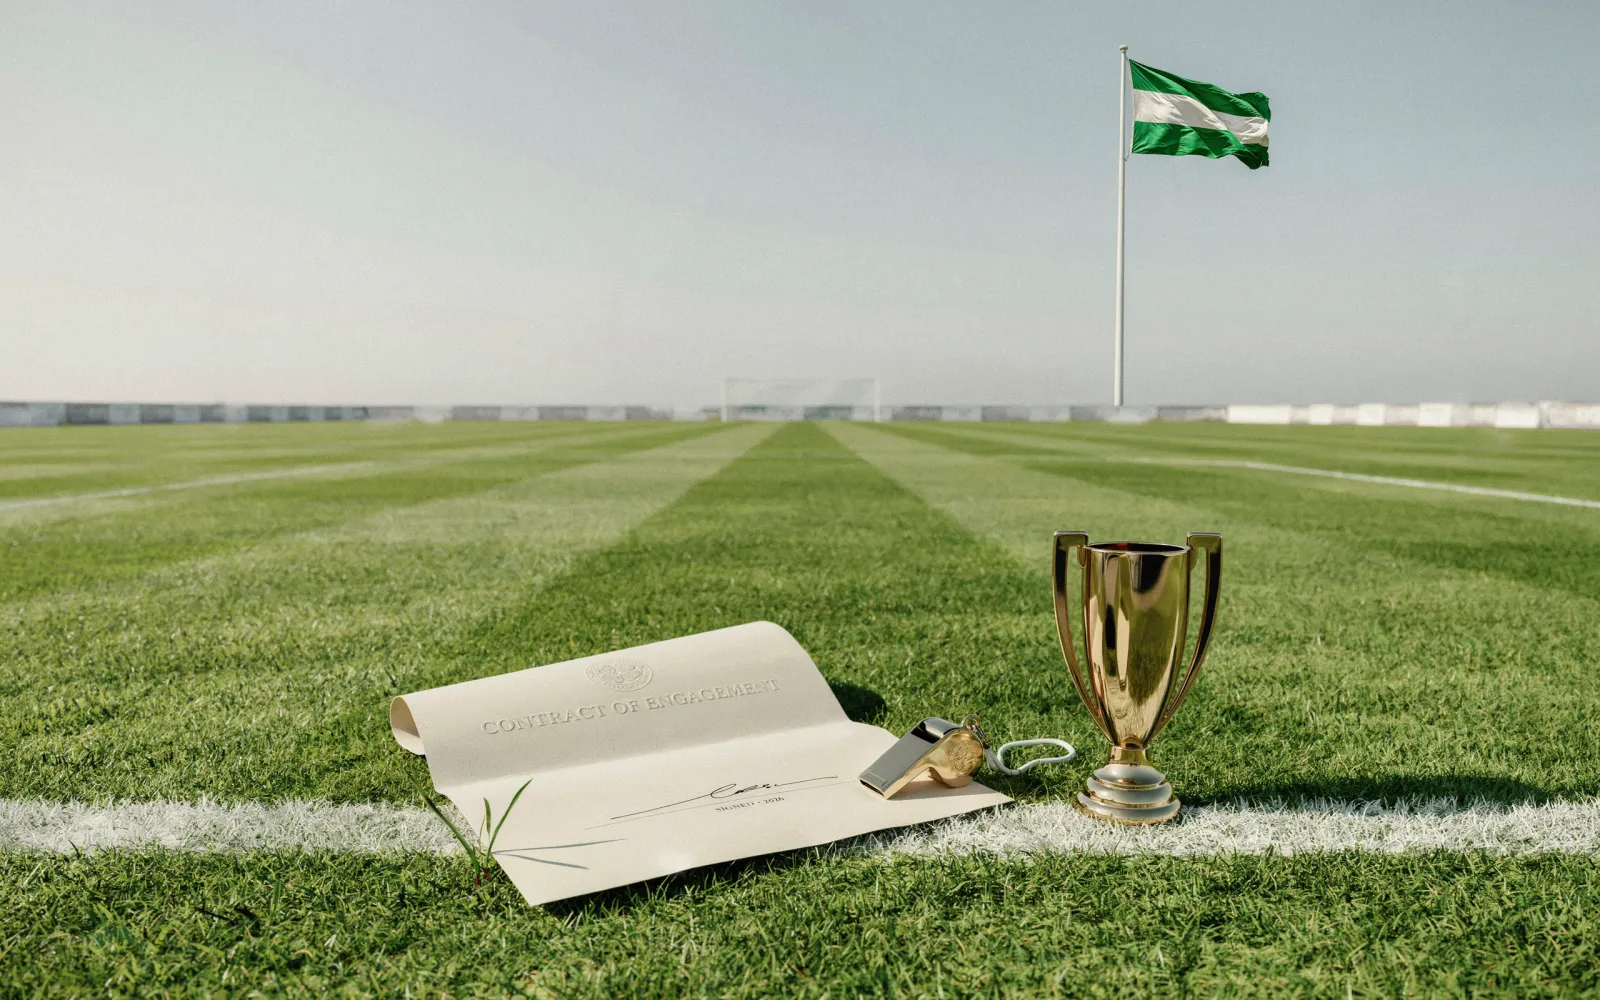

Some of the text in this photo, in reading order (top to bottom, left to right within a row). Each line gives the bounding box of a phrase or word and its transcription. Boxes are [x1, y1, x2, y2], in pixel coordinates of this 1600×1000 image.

[481, 678, 780, 735] CONTRACT OF ENGAGEMENT
[715, 802, 755, 812] SIGNED
